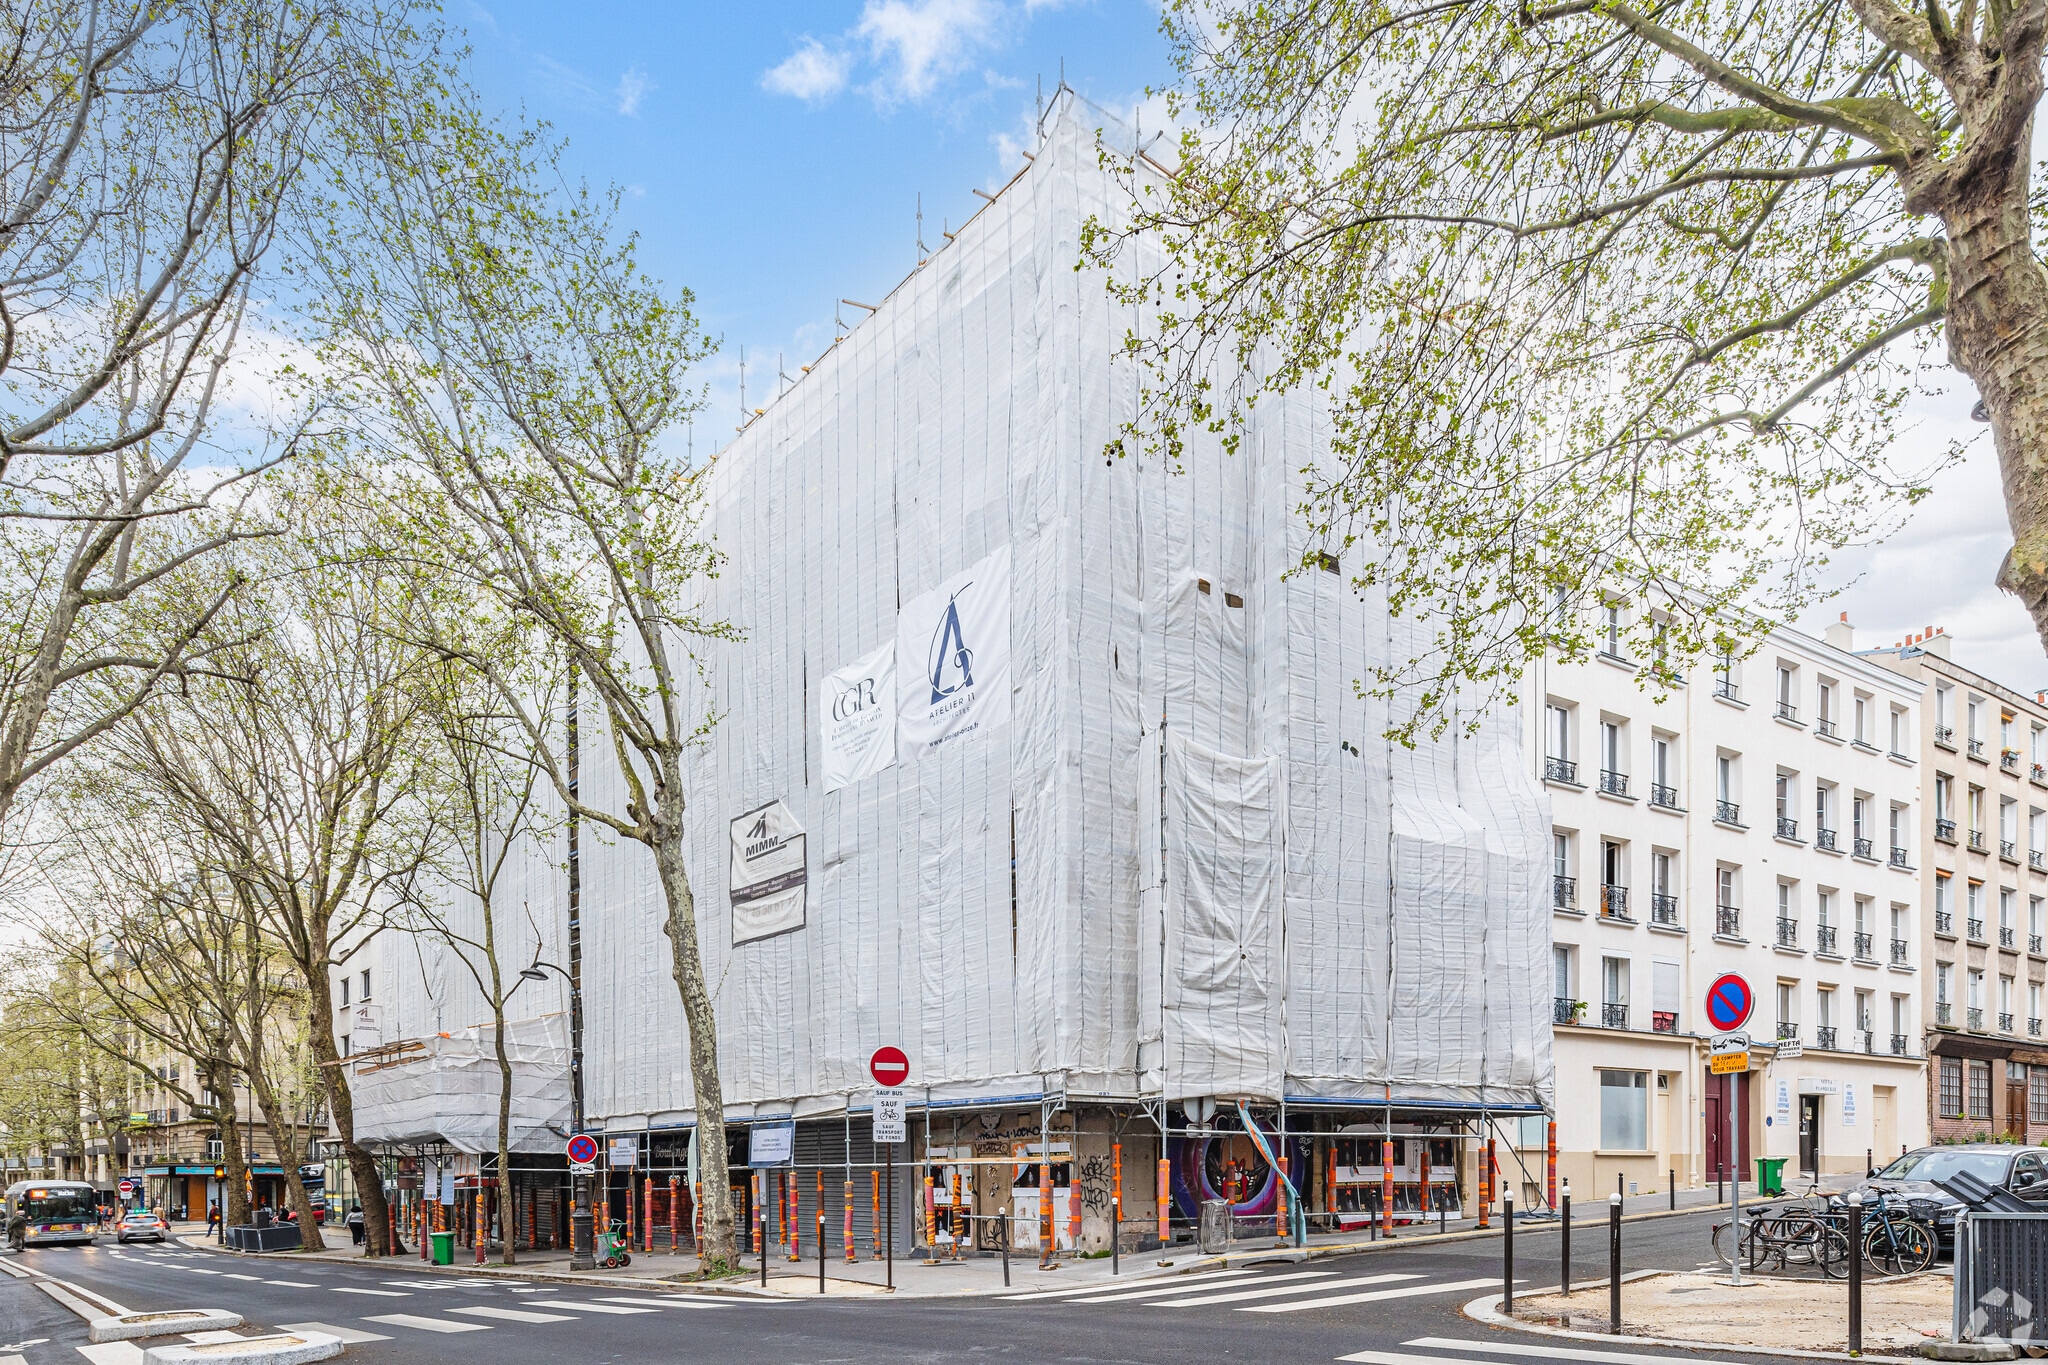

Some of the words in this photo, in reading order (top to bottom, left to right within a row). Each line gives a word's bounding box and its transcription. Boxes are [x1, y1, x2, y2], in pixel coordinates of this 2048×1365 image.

[832, 678, 877, 722] CGR
[929, 697, 964, 719] ATELIER
[745, 835, 779, 857] MIMM
